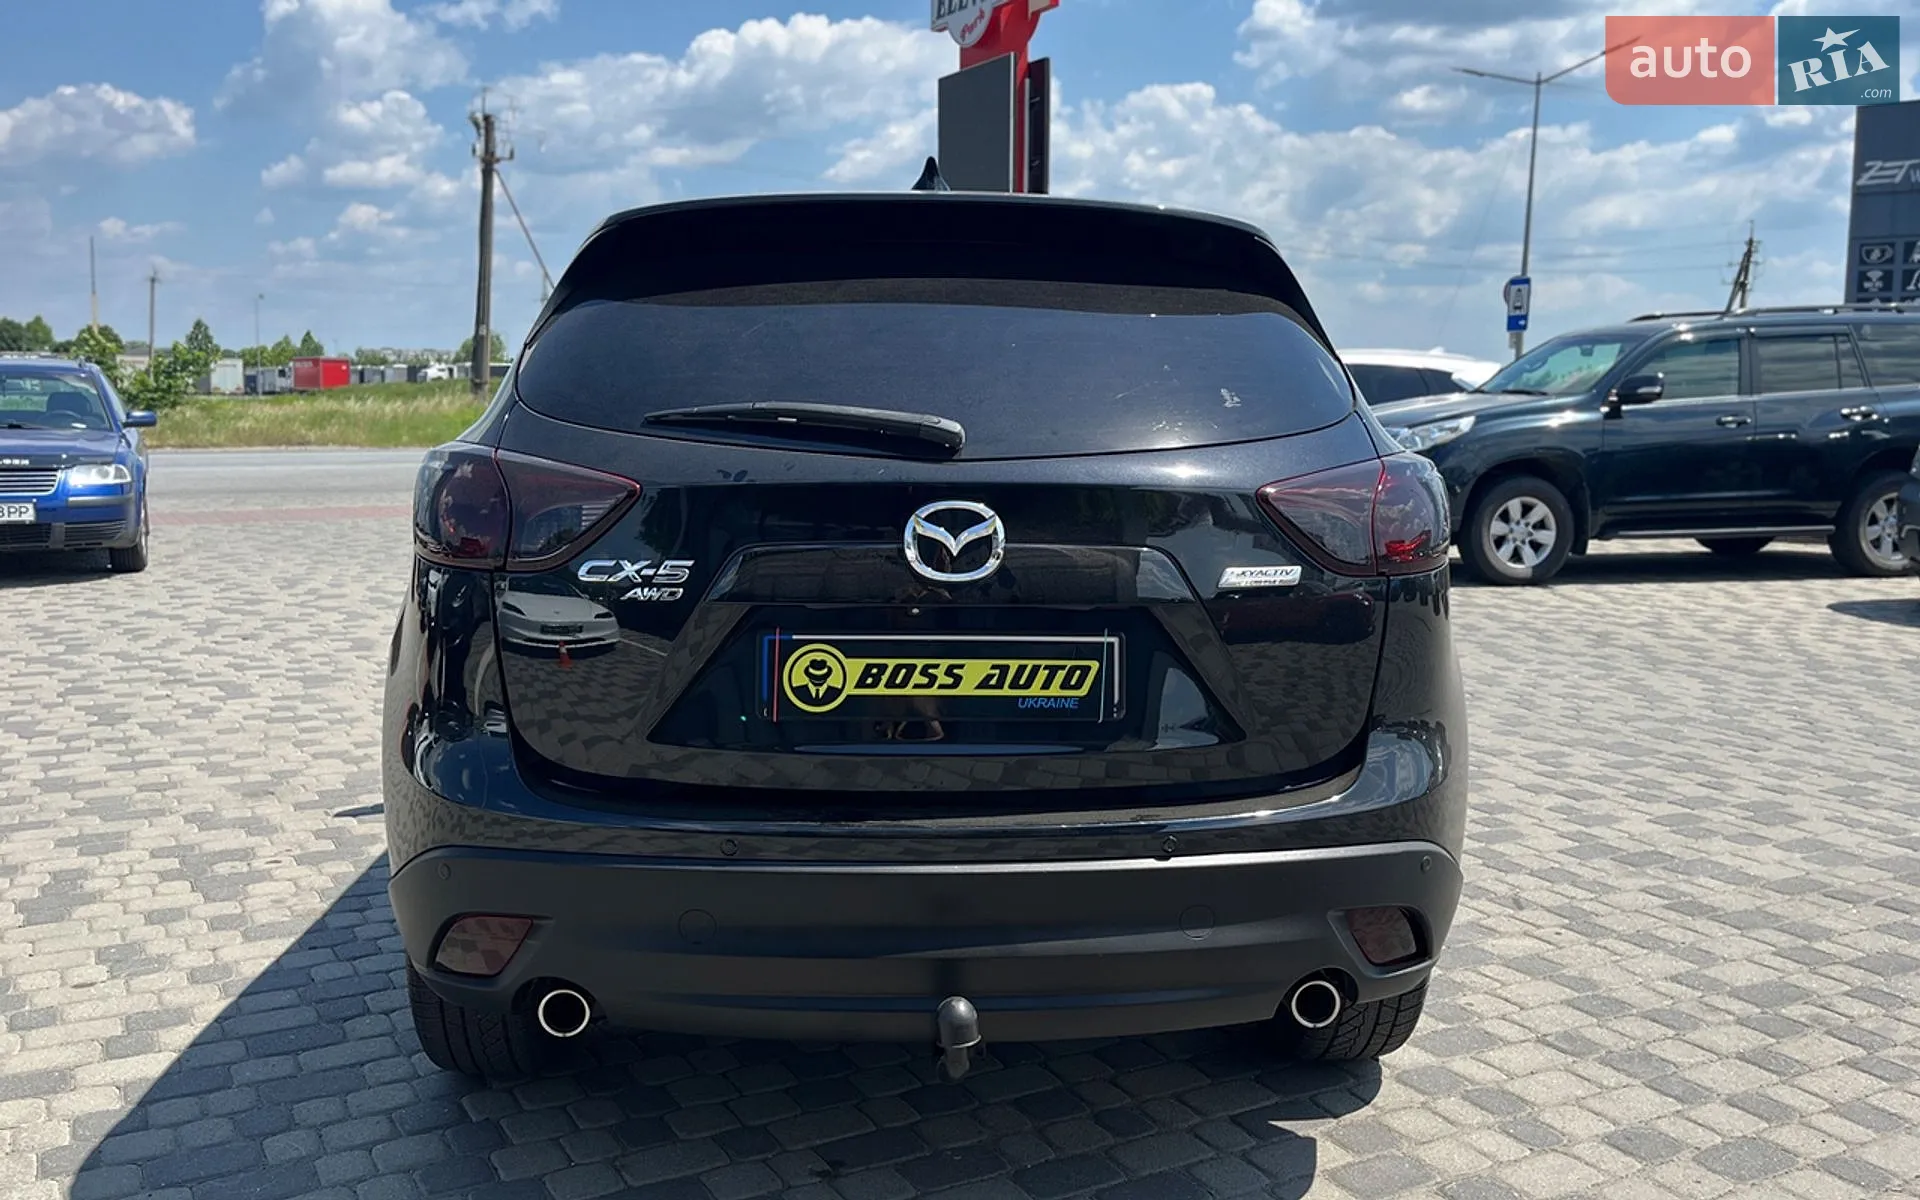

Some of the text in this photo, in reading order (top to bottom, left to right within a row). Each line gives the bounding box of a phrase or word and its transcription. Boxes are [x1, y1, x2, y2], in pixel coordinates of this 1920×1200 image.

[577, 559, 695, 583] CX-5
[1236, 568, 1295, 578] KYACTIV
[620, 587, 684, 601] AWD
[853, 662, 1093, 691] BOSS AUTO
[1017, 697, 1080, 709] UKRAINE
